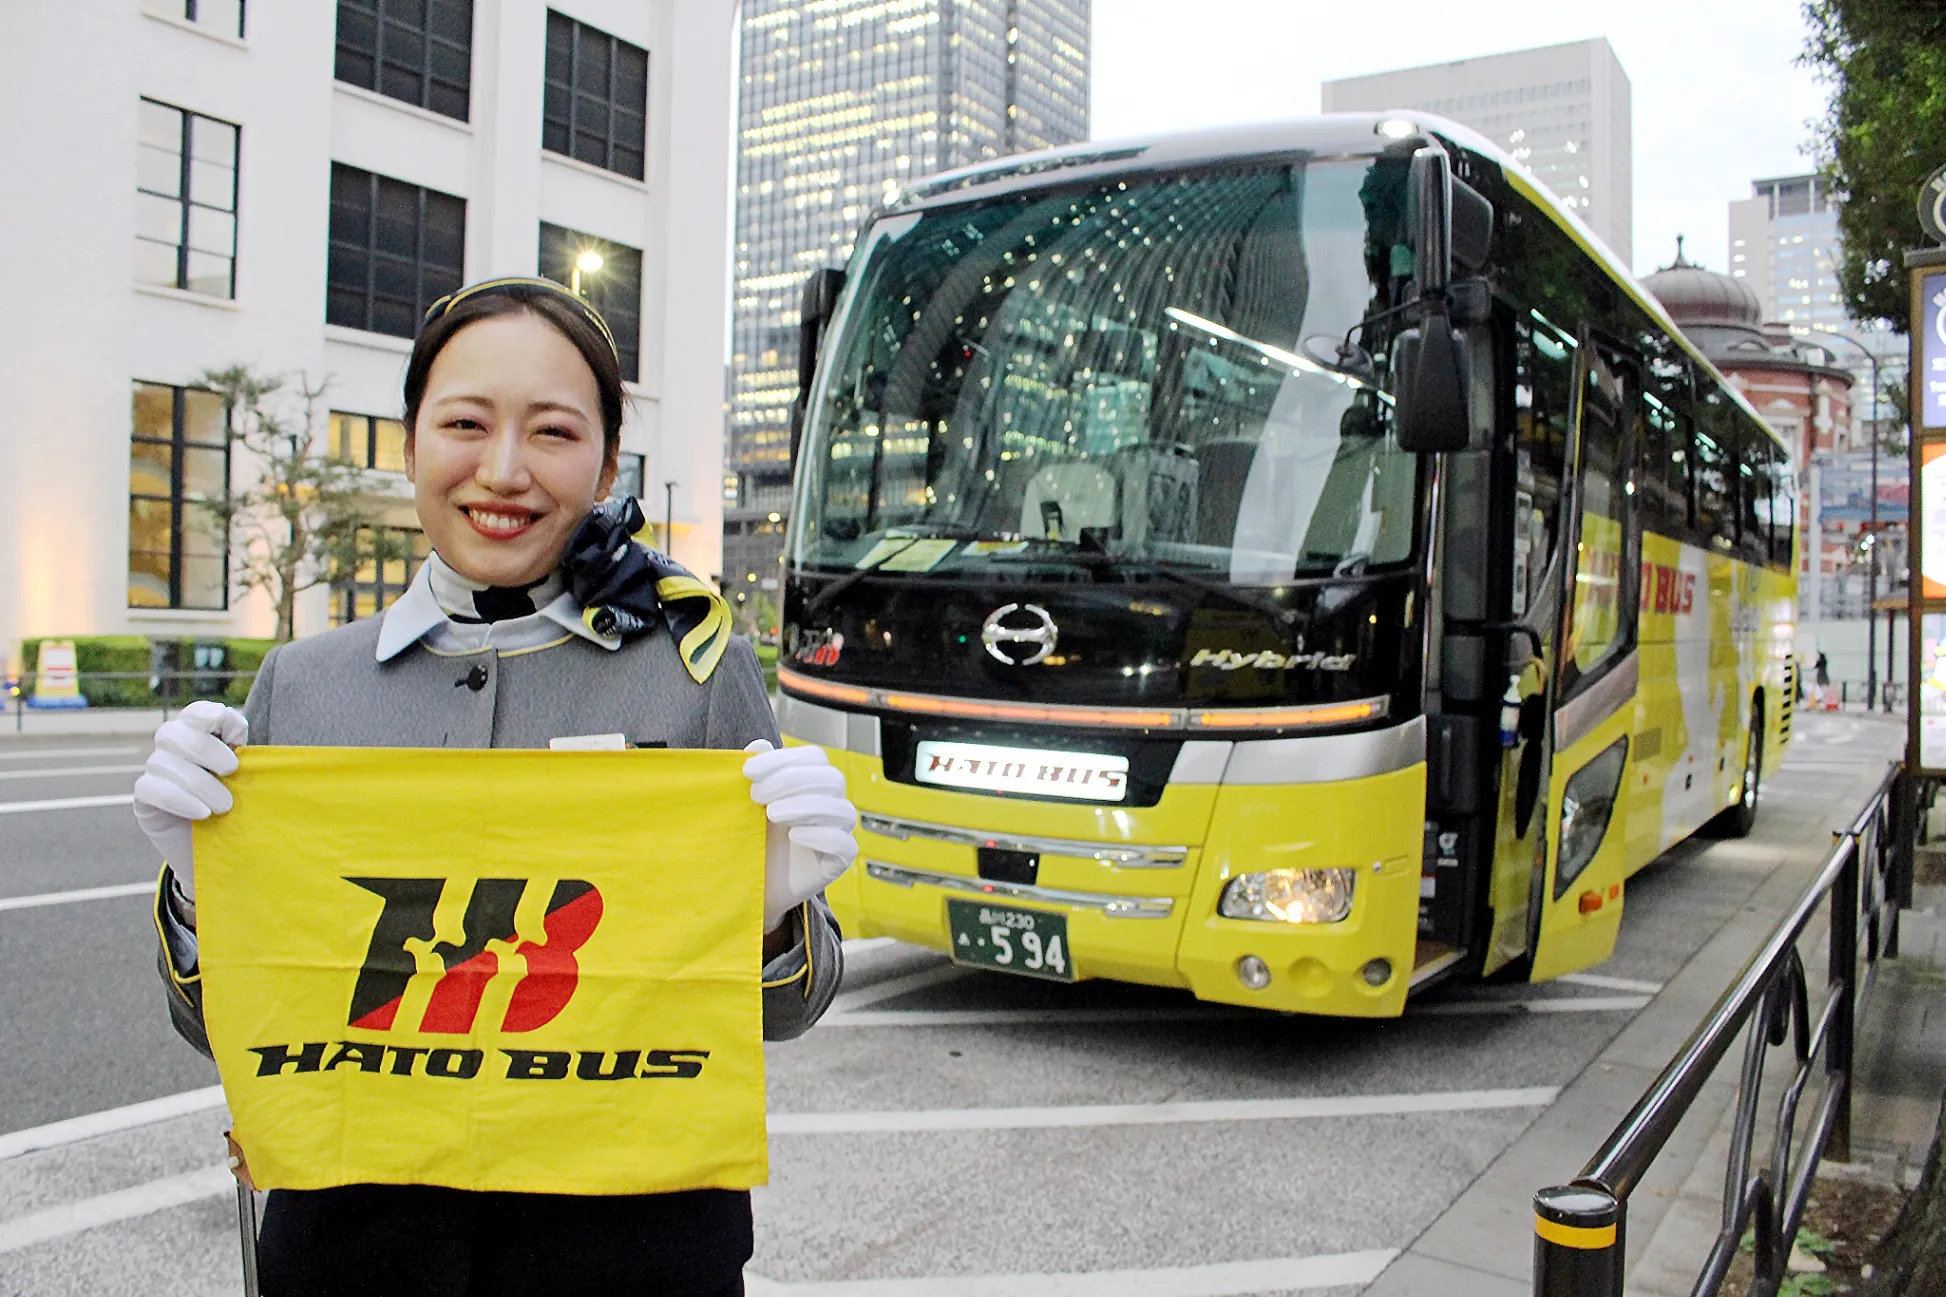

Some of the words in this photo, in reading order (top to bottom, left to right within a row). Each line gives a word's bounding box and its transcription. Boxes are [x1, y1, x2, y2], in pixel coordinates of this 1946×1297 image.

[1653, 564, 1697, 617] BUS
[1189, 649, 1357, 671] Hybrid
[1036, 765, 1129, 788] BUS
[246, 1041, 485, 1079] HATO
[496, 1048, 711, 1081] BUS
